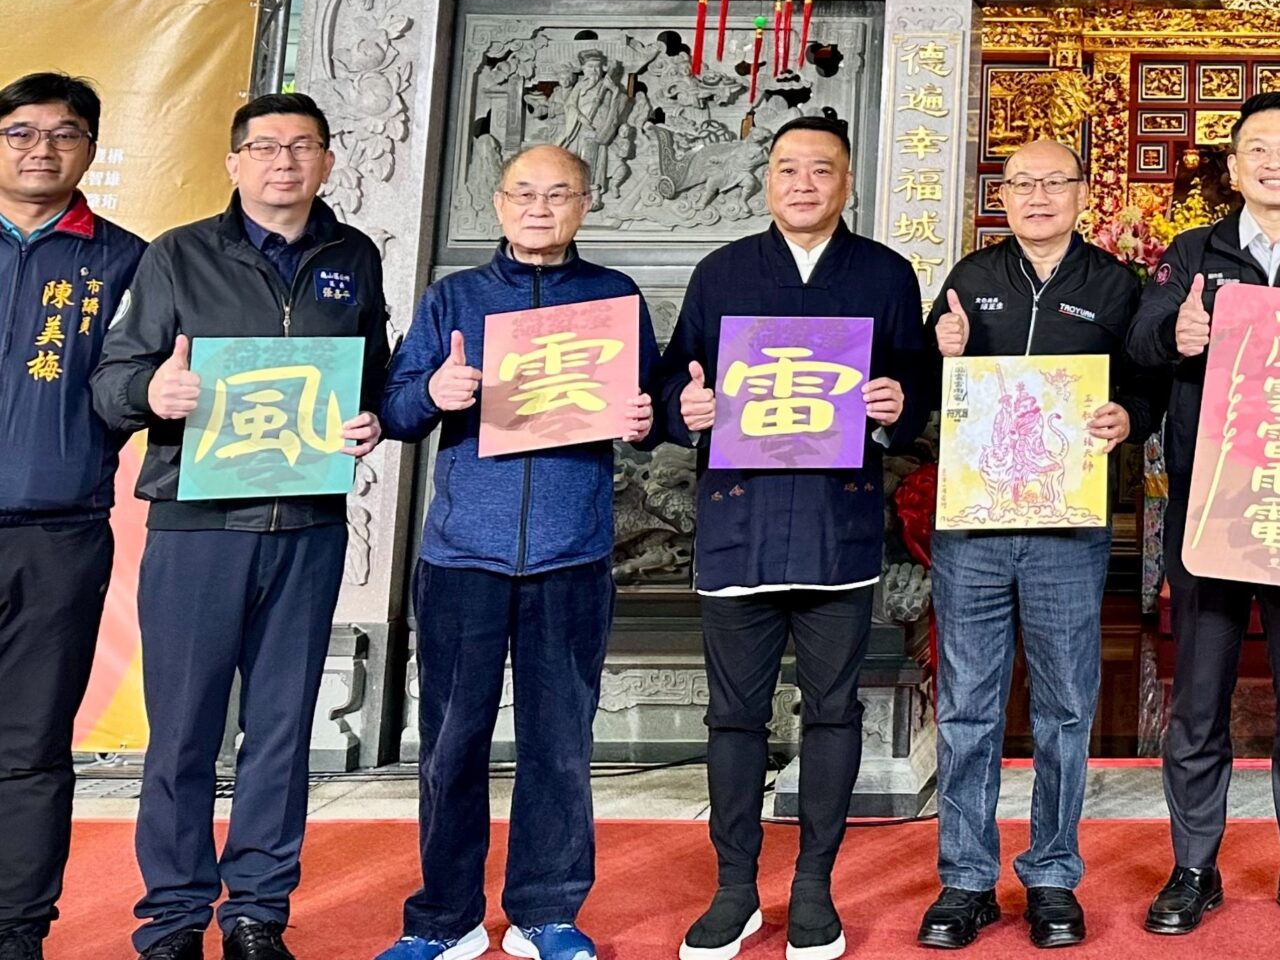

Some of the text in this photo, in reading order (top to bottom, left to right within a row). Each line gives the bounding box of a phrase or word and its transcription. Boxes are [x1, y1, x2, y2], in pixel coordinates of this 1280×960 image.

[892, 41, 952, 316] 德遍幸福城市
[27, 279, 75, 382] 陳美梅
[79, 278, 104, 336] 市議員
[1059, 302, 1096, 319] TAOYUAN
[194, 365, 344, 467] 風
[499, 331, 625, 416] 雲
[722, 346, 864, 437] 雷
